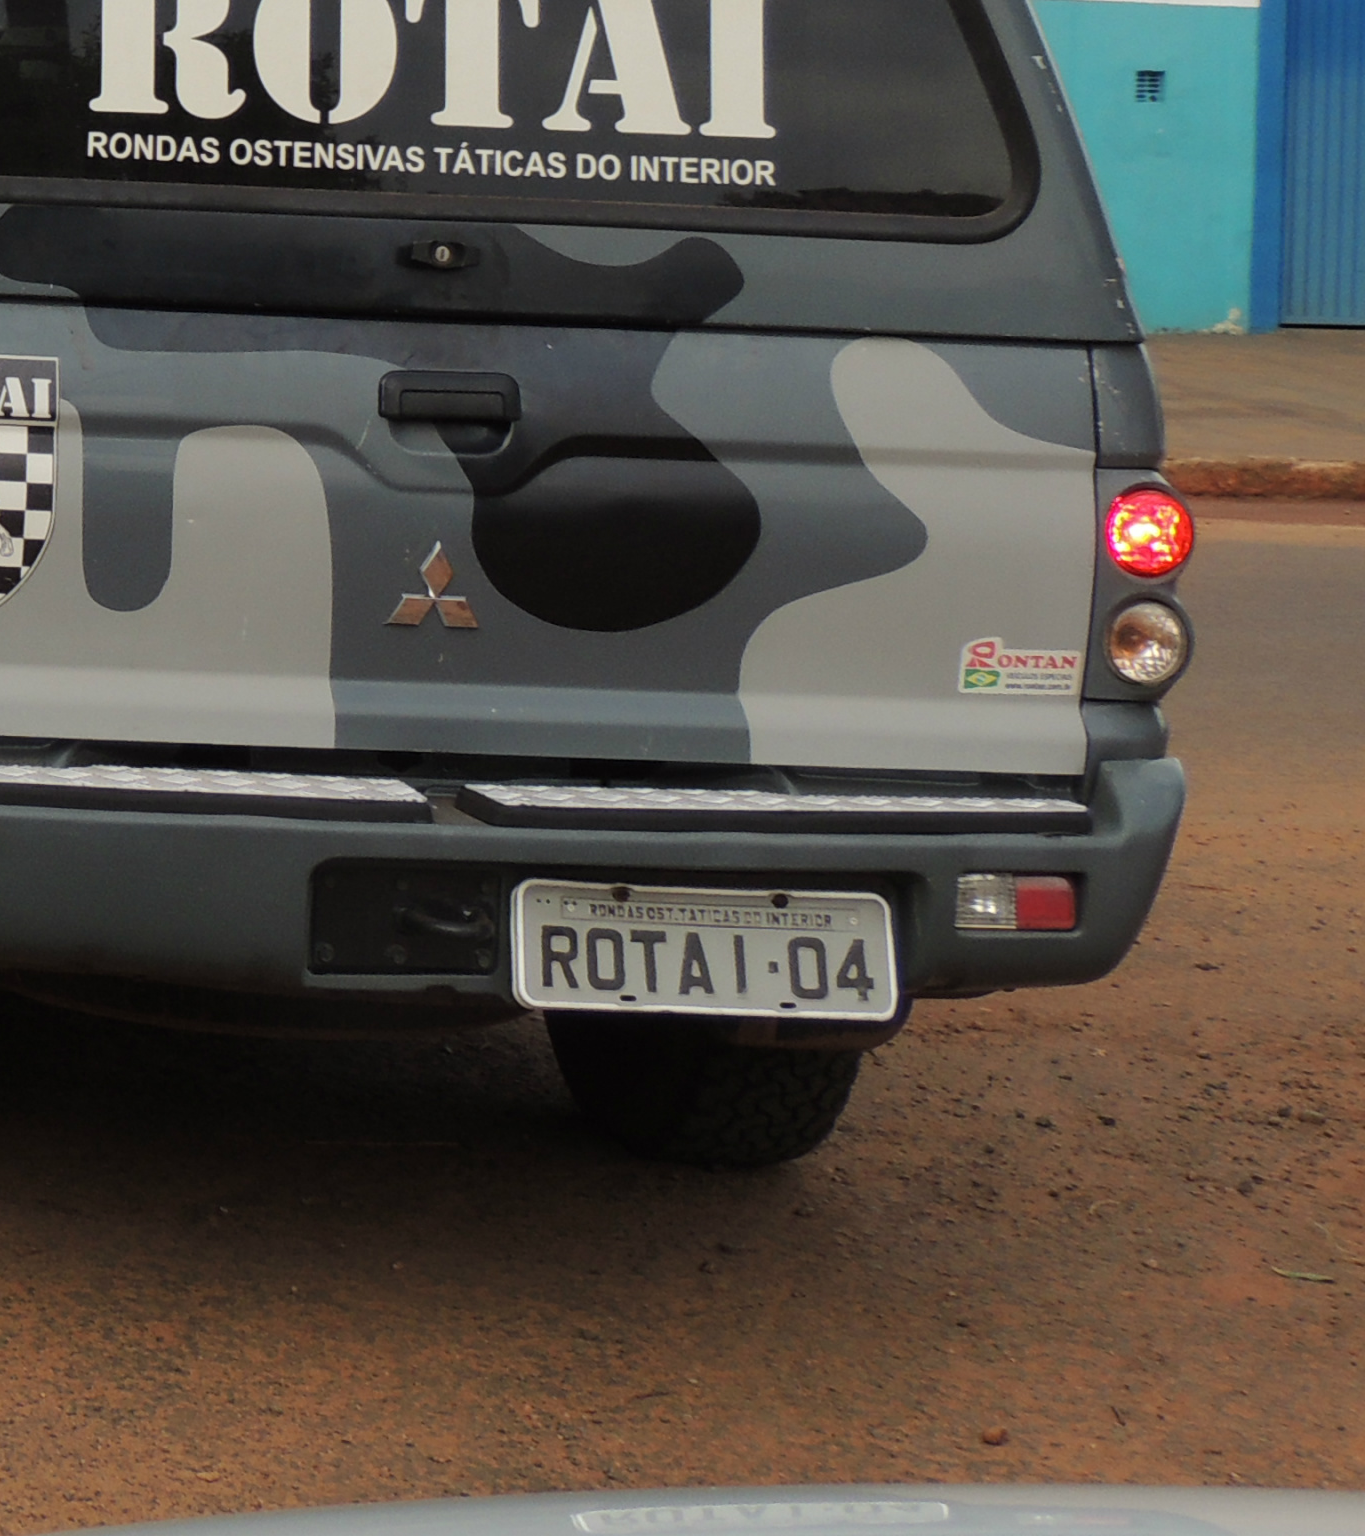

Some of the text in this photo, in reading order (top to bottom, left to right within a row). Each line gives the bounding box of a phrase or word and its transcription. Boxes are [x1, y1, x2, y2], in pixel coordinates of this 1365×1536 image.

[86, 131, 777, 187] RONDAS OSTENSIVAS TÁTICAS DO INTERIOR
[589, 903, 644, 919] RONDAS
[765, 911, 832, 928] INTERIOR
